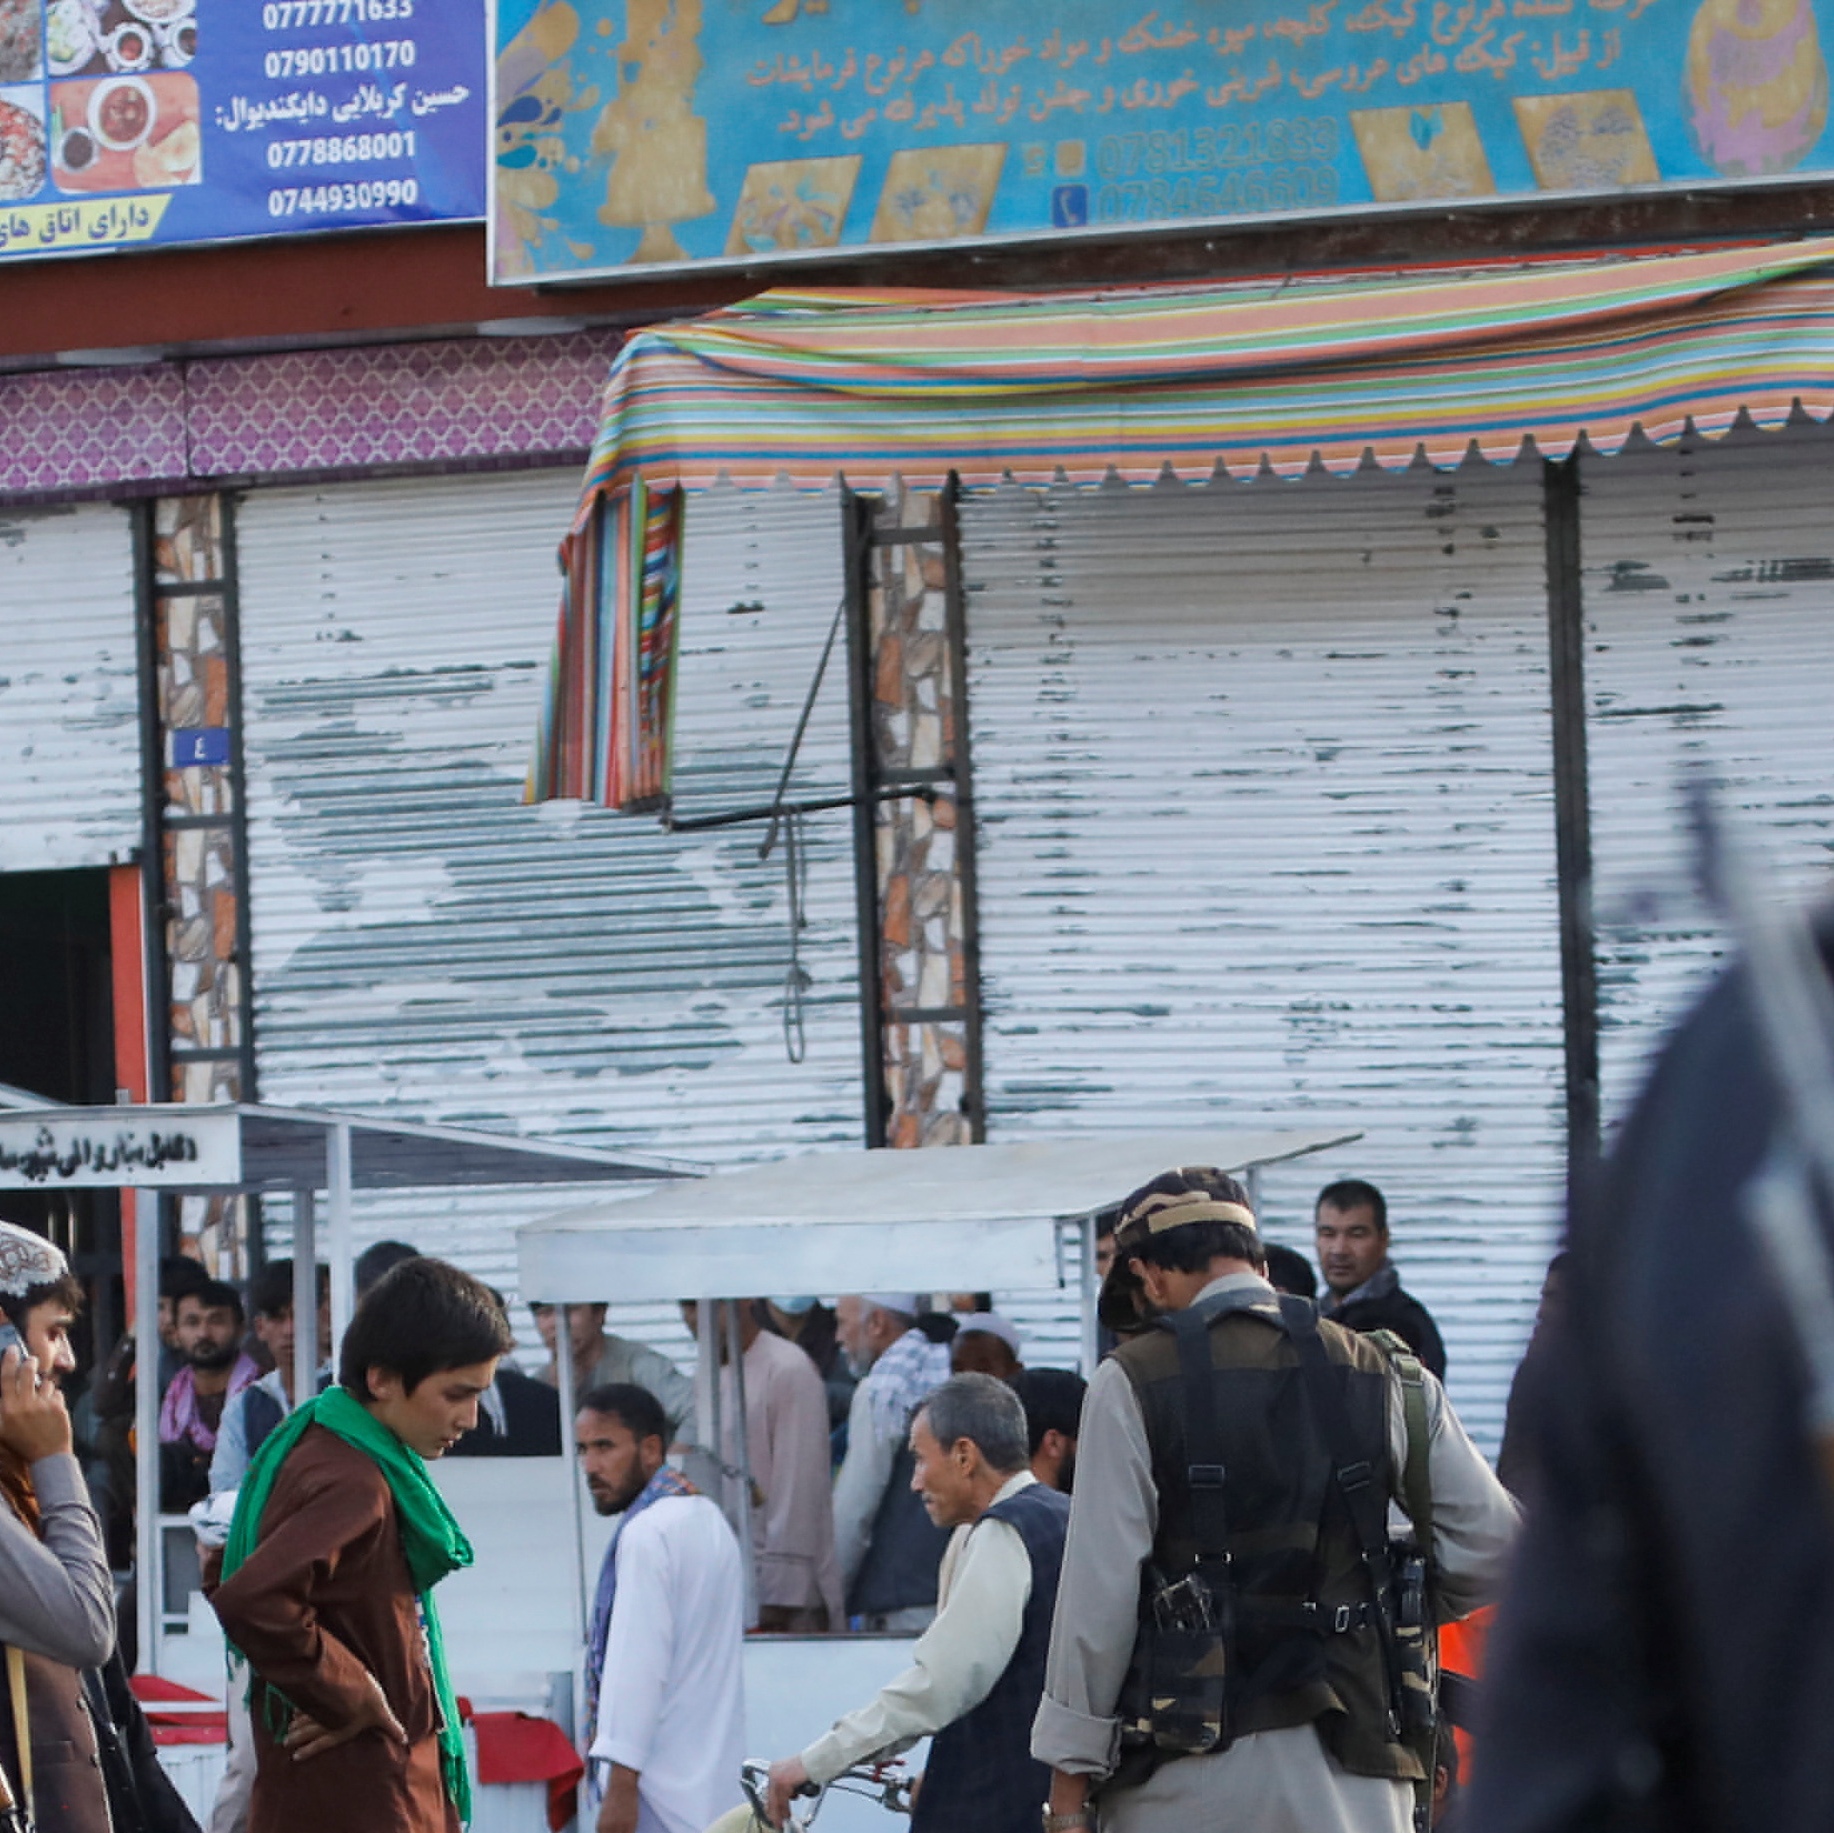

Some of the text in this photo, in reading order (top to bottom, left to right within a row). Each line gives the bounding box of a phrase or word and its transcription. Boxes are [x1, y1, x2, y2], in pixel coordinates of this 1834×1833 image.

[266, 40, 415, 78] 0790110170
[412, 85, 470, 116] حسین
[268, 131, 415, 168] 0778868001
[268, 180, 417, 216] 0744930990
[38, 211, 81, 244] اتاق
[89, 205, 150, 240] دارای
